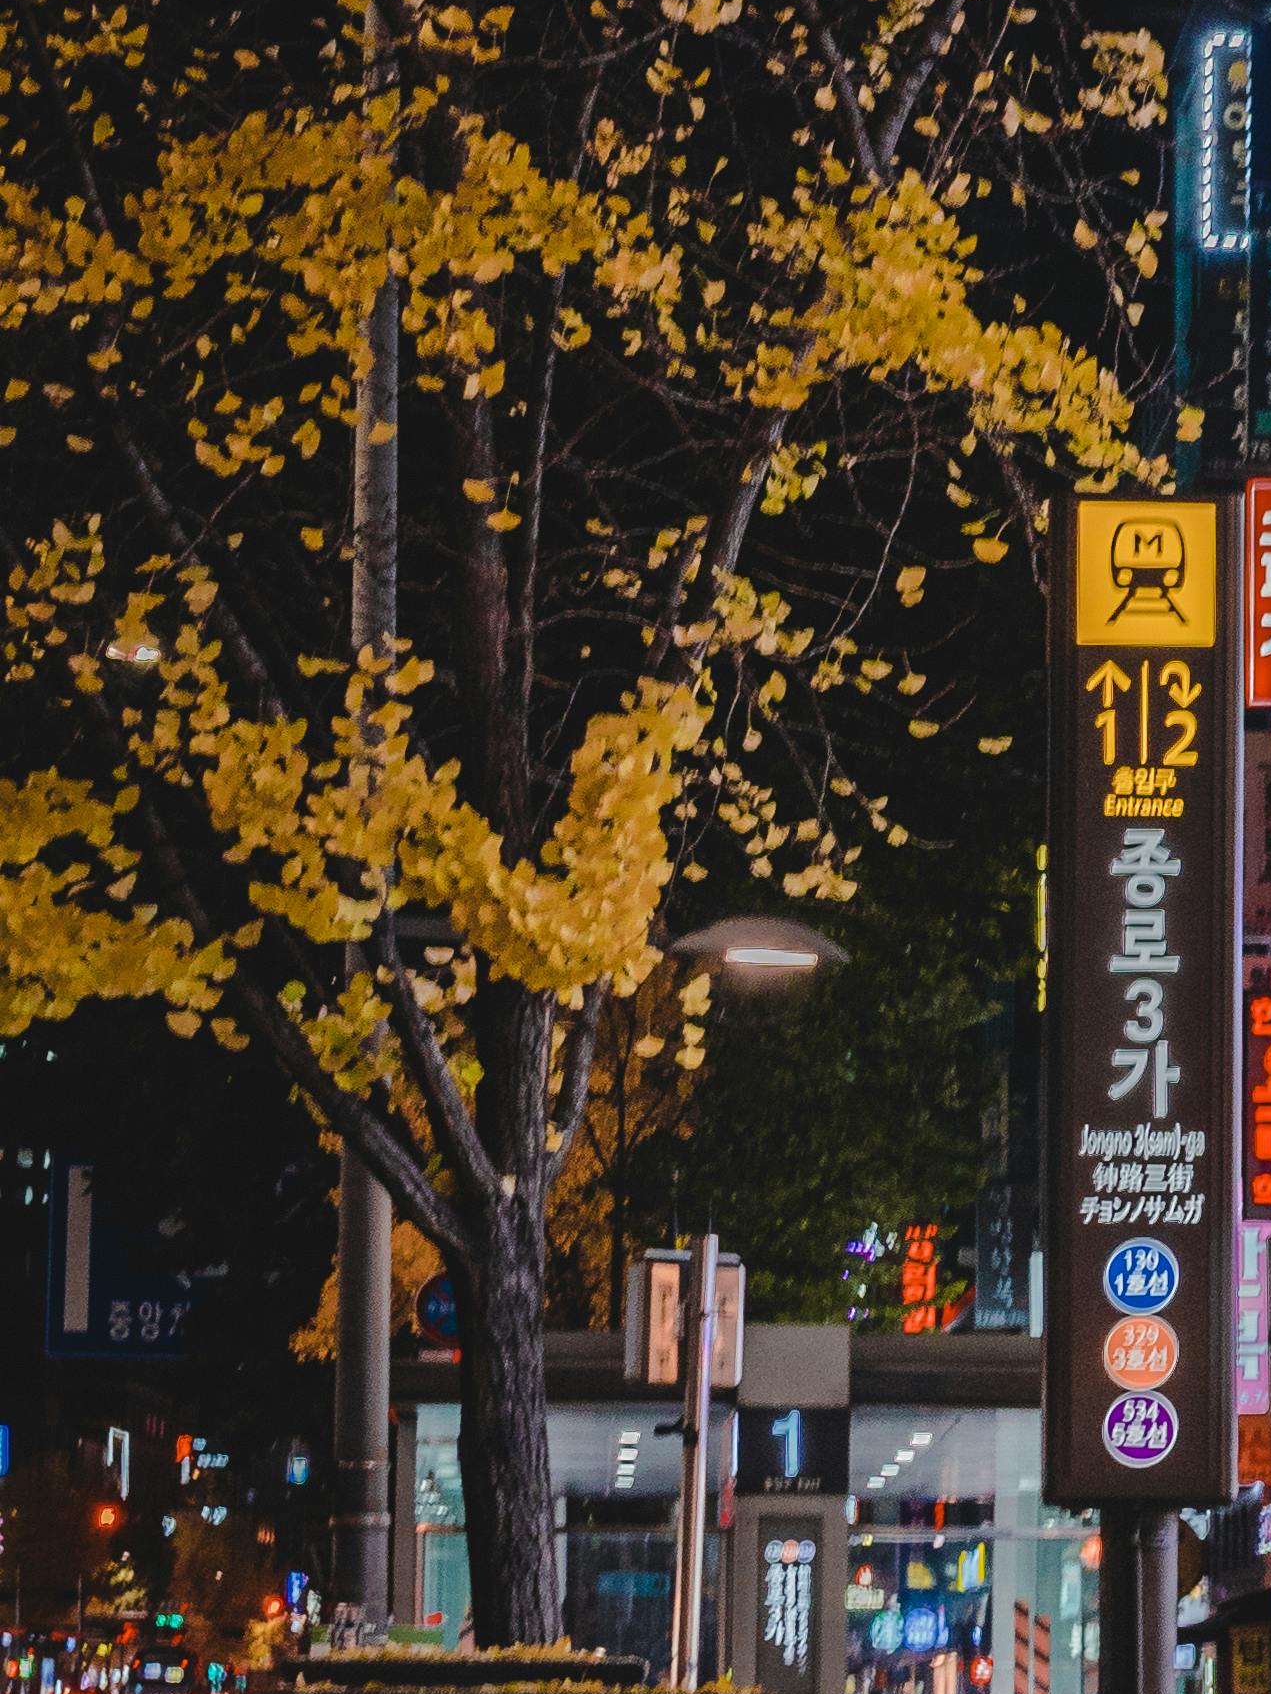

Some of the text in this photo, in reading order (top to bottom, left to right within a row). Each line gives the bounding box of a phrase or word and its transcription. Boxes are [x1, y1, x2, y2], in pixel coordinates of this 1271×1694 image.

[1095, 708, 1199, 766] 1 2
[1112, 766, 1177, 794] 출입구
[1103, 794, 1185, 818] Entrance
[1109, 827, 1182, 1119] 종로3가
[1078, 1123, 1132, 1160] Jongno
[1122, 1249, 1160, 1272] 130
[1113, 1271, 1169, 1297] 1호선
[1122, 1324, 1160, 1347] 329
[1111, 1345, 1169, 1372] 3호선
[1121, 1399, 1160, 1424] 534
[770, 1408, 802, 1479] 1
[1110, 1422, 1169, 1450] 5호선
